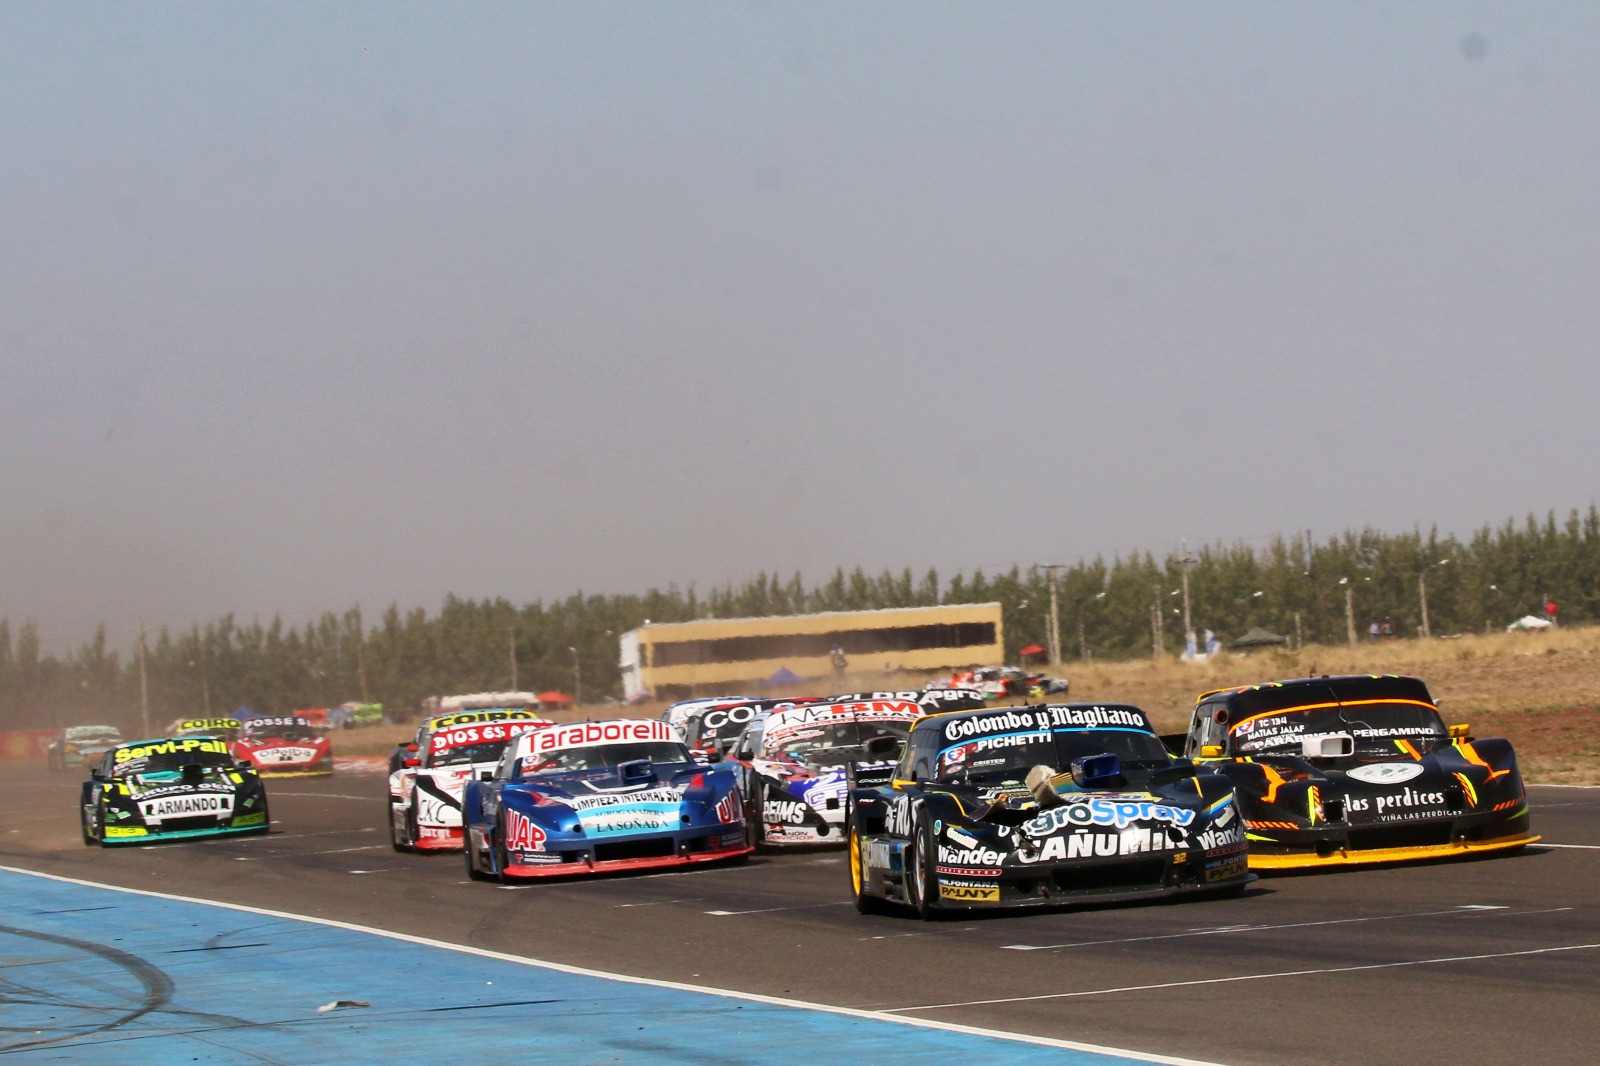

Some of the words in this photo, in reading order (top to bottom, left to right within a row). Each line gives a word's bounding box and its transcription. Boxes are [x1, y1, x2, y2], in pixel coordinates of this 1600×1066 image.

[831, 702, 919, 714] BM
[181, 718, 240, 730] COIRO
[436, 712, 532, 728] COIRO
[945, 711, 1034, 741] Colombo
[1036, 711, 1051, 731] y
[1048, 706, 1145, 729] Magliano
[1258, 719, 1269, 728] TC
[1271, 716, 1288, 726] 134
[433, 729, 479, 748] DIOS
[482, 726, 506, 739] ES
[525, 722, 670, 752] Taraborelli
[1247, 728, 1277, 740] MATIAS
[1280, 724, 1305, 735] JALAF
[1353, 727, 1435, 738] PERGAMINO
[978, 733, 1052, 752] PICHETTI
[130, 784, 194, 800] GRUPO
[1344, 793, 1370, 812] las
[1376, 786, 1445, 813] perdices
[158, 797, 218, 815] ARMANDO
[571, 796, 620, 812] LIMPIEZA
[620, 791, 666, 803] INTEGRAL
[762, 800, 807, 824] REIMS
[1381, 812, 1403, 822] VIÑA
[1404, 812, 1420, 820] LAS
[1422, 809, 1462, 819] PERDICES
[506, 809, 547, 852] UAP
[596, 822, 613, 833] LA
[616, 818, 669, 832] SOÑADA
[938, 846, 1008, 866] Wander
[1173, 852, 1187, 864] 32
[941, 886, 997, 899] PAUNY
